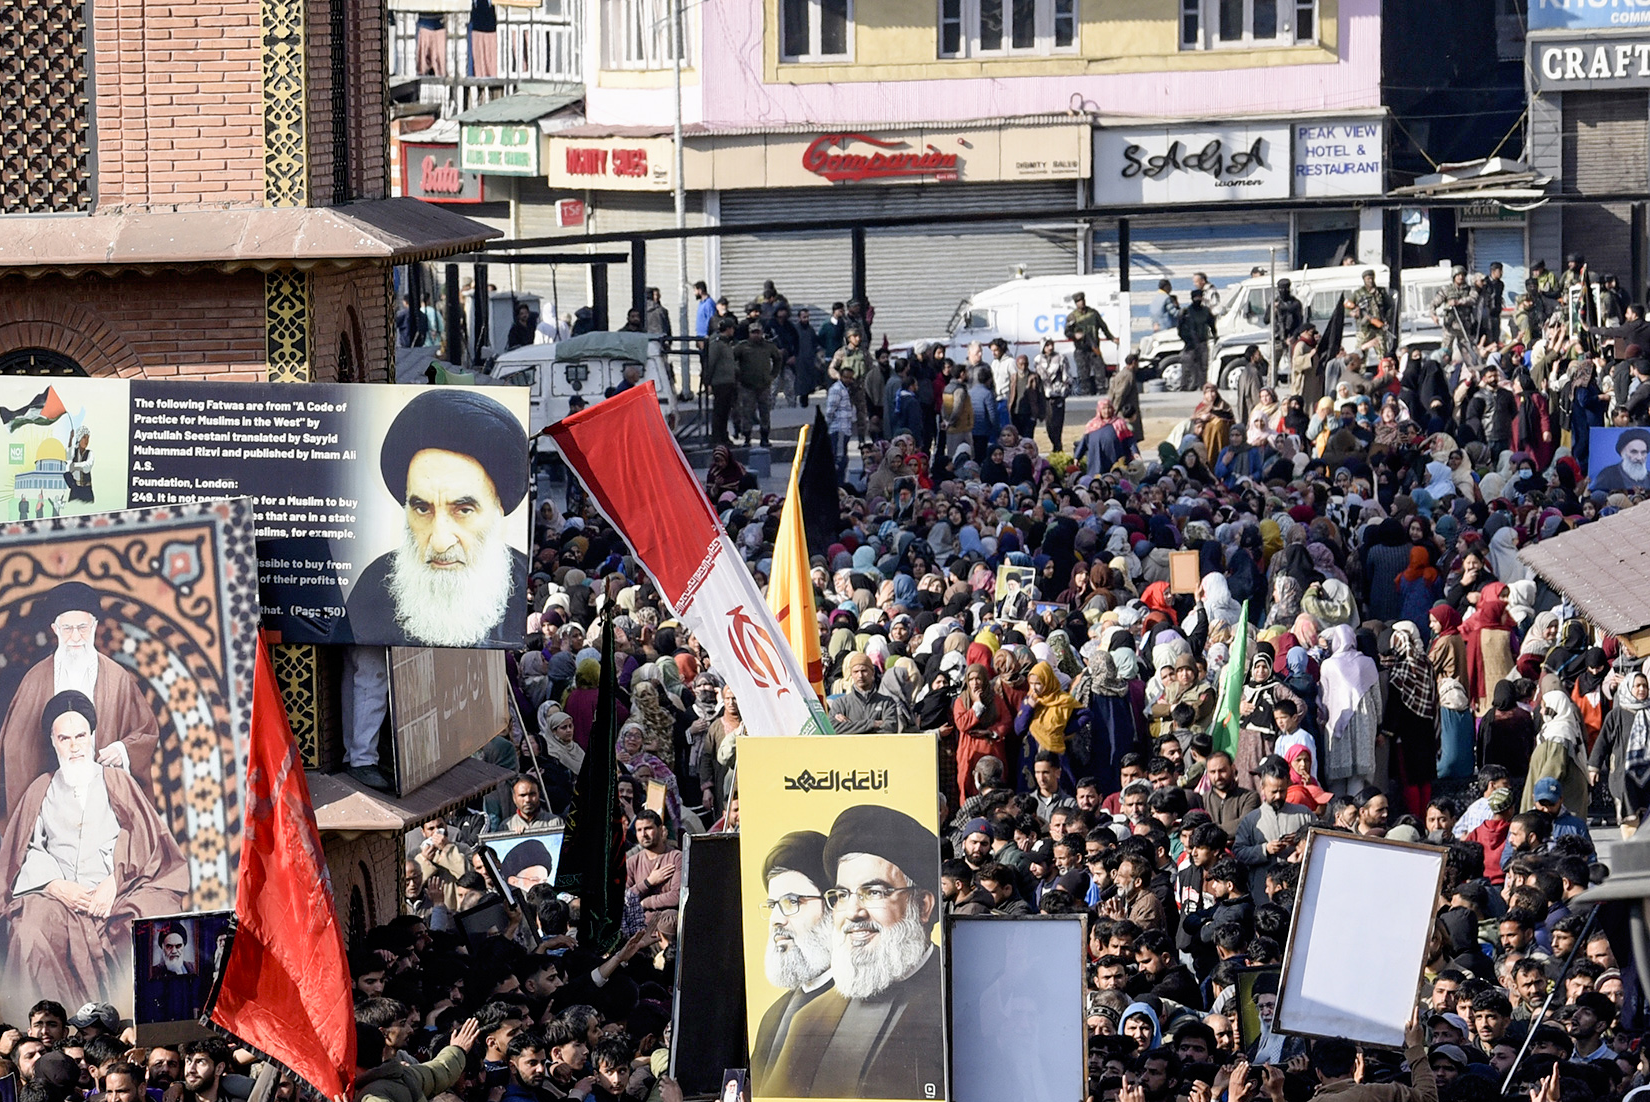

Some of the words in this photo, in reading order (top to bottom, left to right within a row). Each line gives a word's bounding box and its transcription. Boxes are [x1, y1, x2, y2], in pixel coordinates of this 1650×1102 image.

[1298, 127, 1335, 140] PEAK
[1343, 125, 1377, 138] VIEW
[803, 133, 958, 181] Companion
[1305, 145, 1350, 157] HOTEL
[1357, 144, 1366, 156] &
[420, 154, 461, 193] Bata
[1295, 161, 1380, 176] RESTAURANT
[1215, 178, 1263, 188] women
[1463, 206, 1500, 216] KHAN
[135, 398, 154, 408] The
[156, 399, 204, 411] following
[207, 400, 244, 410] Fatwas
[266, 401, 291, 411] from
[307, 402, 334, 412] Code
[336, 403, 347, 412] of
[134, 414, 178, 424] Practice
[180, 415, 196, 424] for
[198, 416, 240, 426] Muslims
[242, 416, 252, 426] in
[254, 417, 271, 426] the
[274, 417, 305, 427] West"
[307, 418, 320, 429] by
[134, 430, 182, 441] Ayatullah
[184, 431, 230, 441] Seestani
[232, 433, 286, 442] translated
[288, 433, 301, 445] by
[303, 433, 338, 445] Sayyid
[134, 445, 193, 456] Muhammad
[195, 447, 220, 456] Rizvi
[222, 448, 241, 457] and
[243, 448, 294, 459] published
[296, 449, 309, 461] by
[311, 449, 340, 459] Imam
[342, 451, 356, 460] Ali
[133, 461, 154, 470] A.S.
[133, 477, 192, 488] Foundation,
[195, 479, 238, 488] London:
[132, 492, 155, 502] 249.
[158, 493, 165, 502] It
[167, 493, 176, 502] is
[261, 496, 277, 505] for
[287, 496, 323, 506] Muslim
[326, 498, 337, 506] to
[339, 498, 357, 508] buy
[266, 511, 287, 521] that
[309, 512, 318, 522] in
[329, 513, 355, 522] state
[291, 528, 307, 537] for
[309, 529, 356, 539] example,
[292, 560, 303, 568] to
[305, 560, 324, 571] buy
[325, 561, 351, 570] from
[274, 575, 297, 583] their
[300, 576, 335, 586] profits
[338, 576, 348, 585] to
